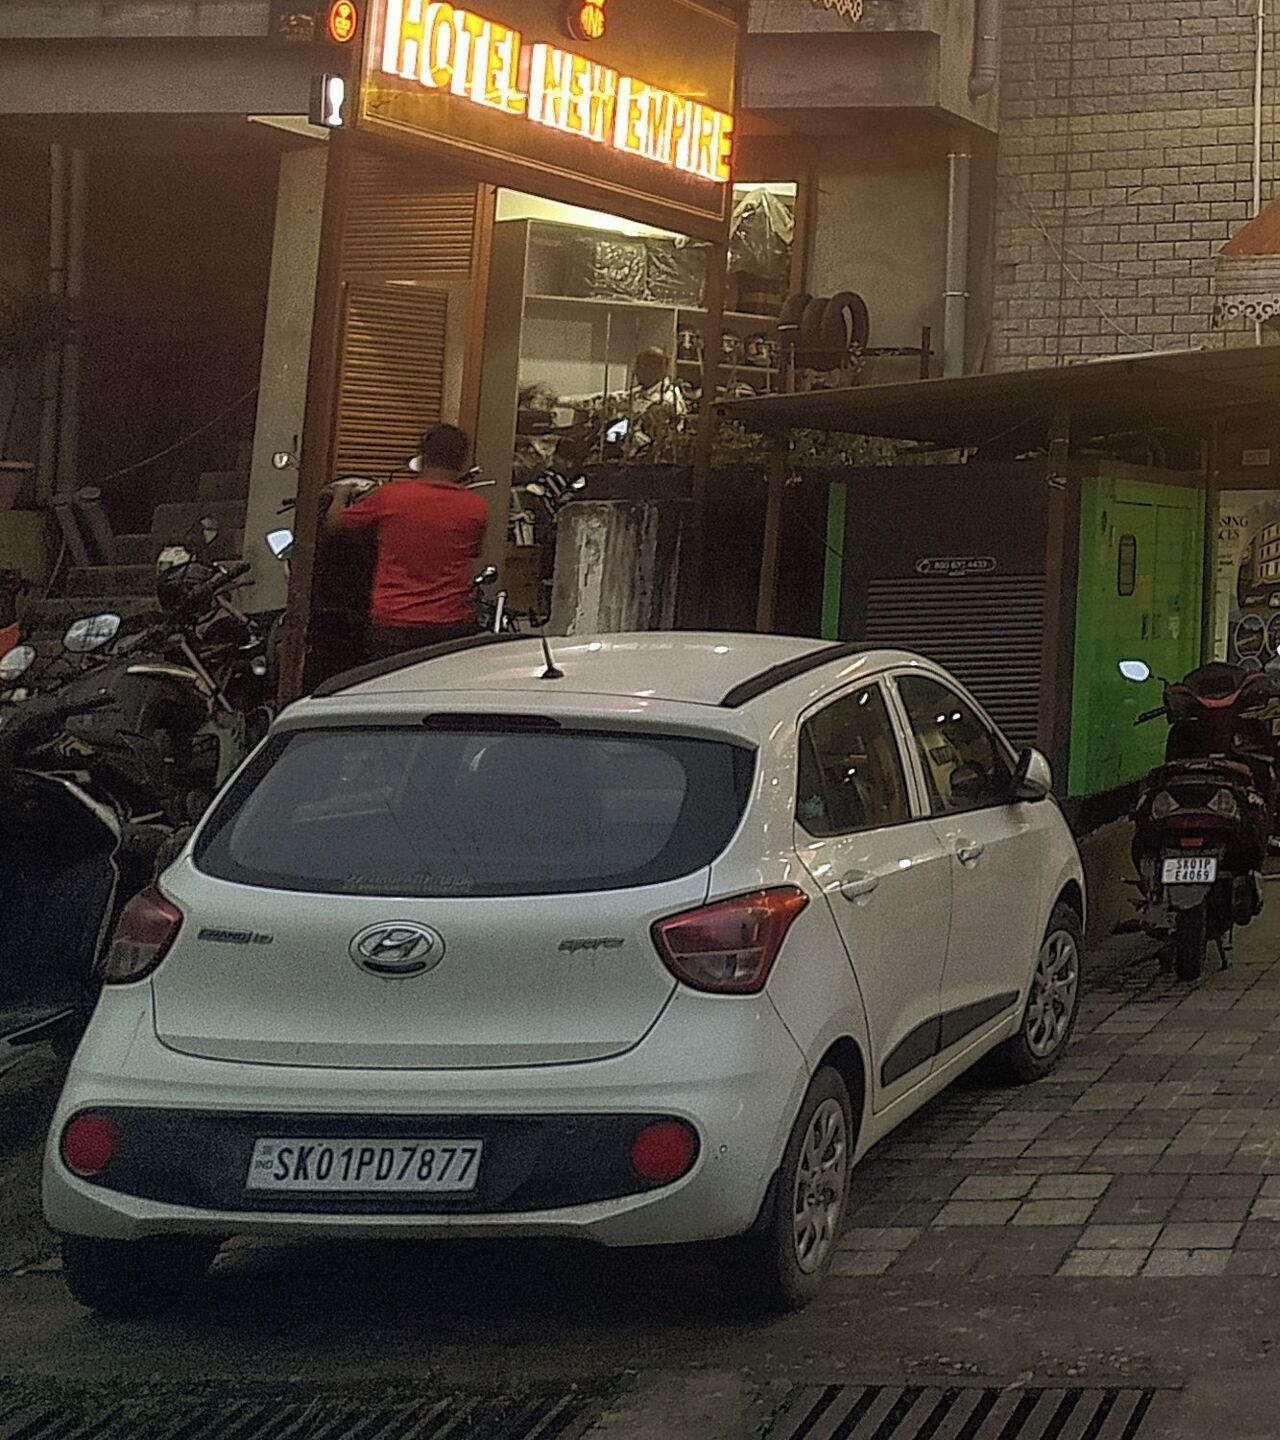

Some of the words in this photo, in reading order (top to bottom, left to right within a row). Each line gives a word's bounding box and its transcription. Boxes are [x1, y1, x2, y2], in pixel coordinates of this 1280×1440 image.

[527, 43, 619, 143] NEW
[613, 76, 735, 183] EMPIRE
[273, 1146, 477, 1181] SK01PD7877
